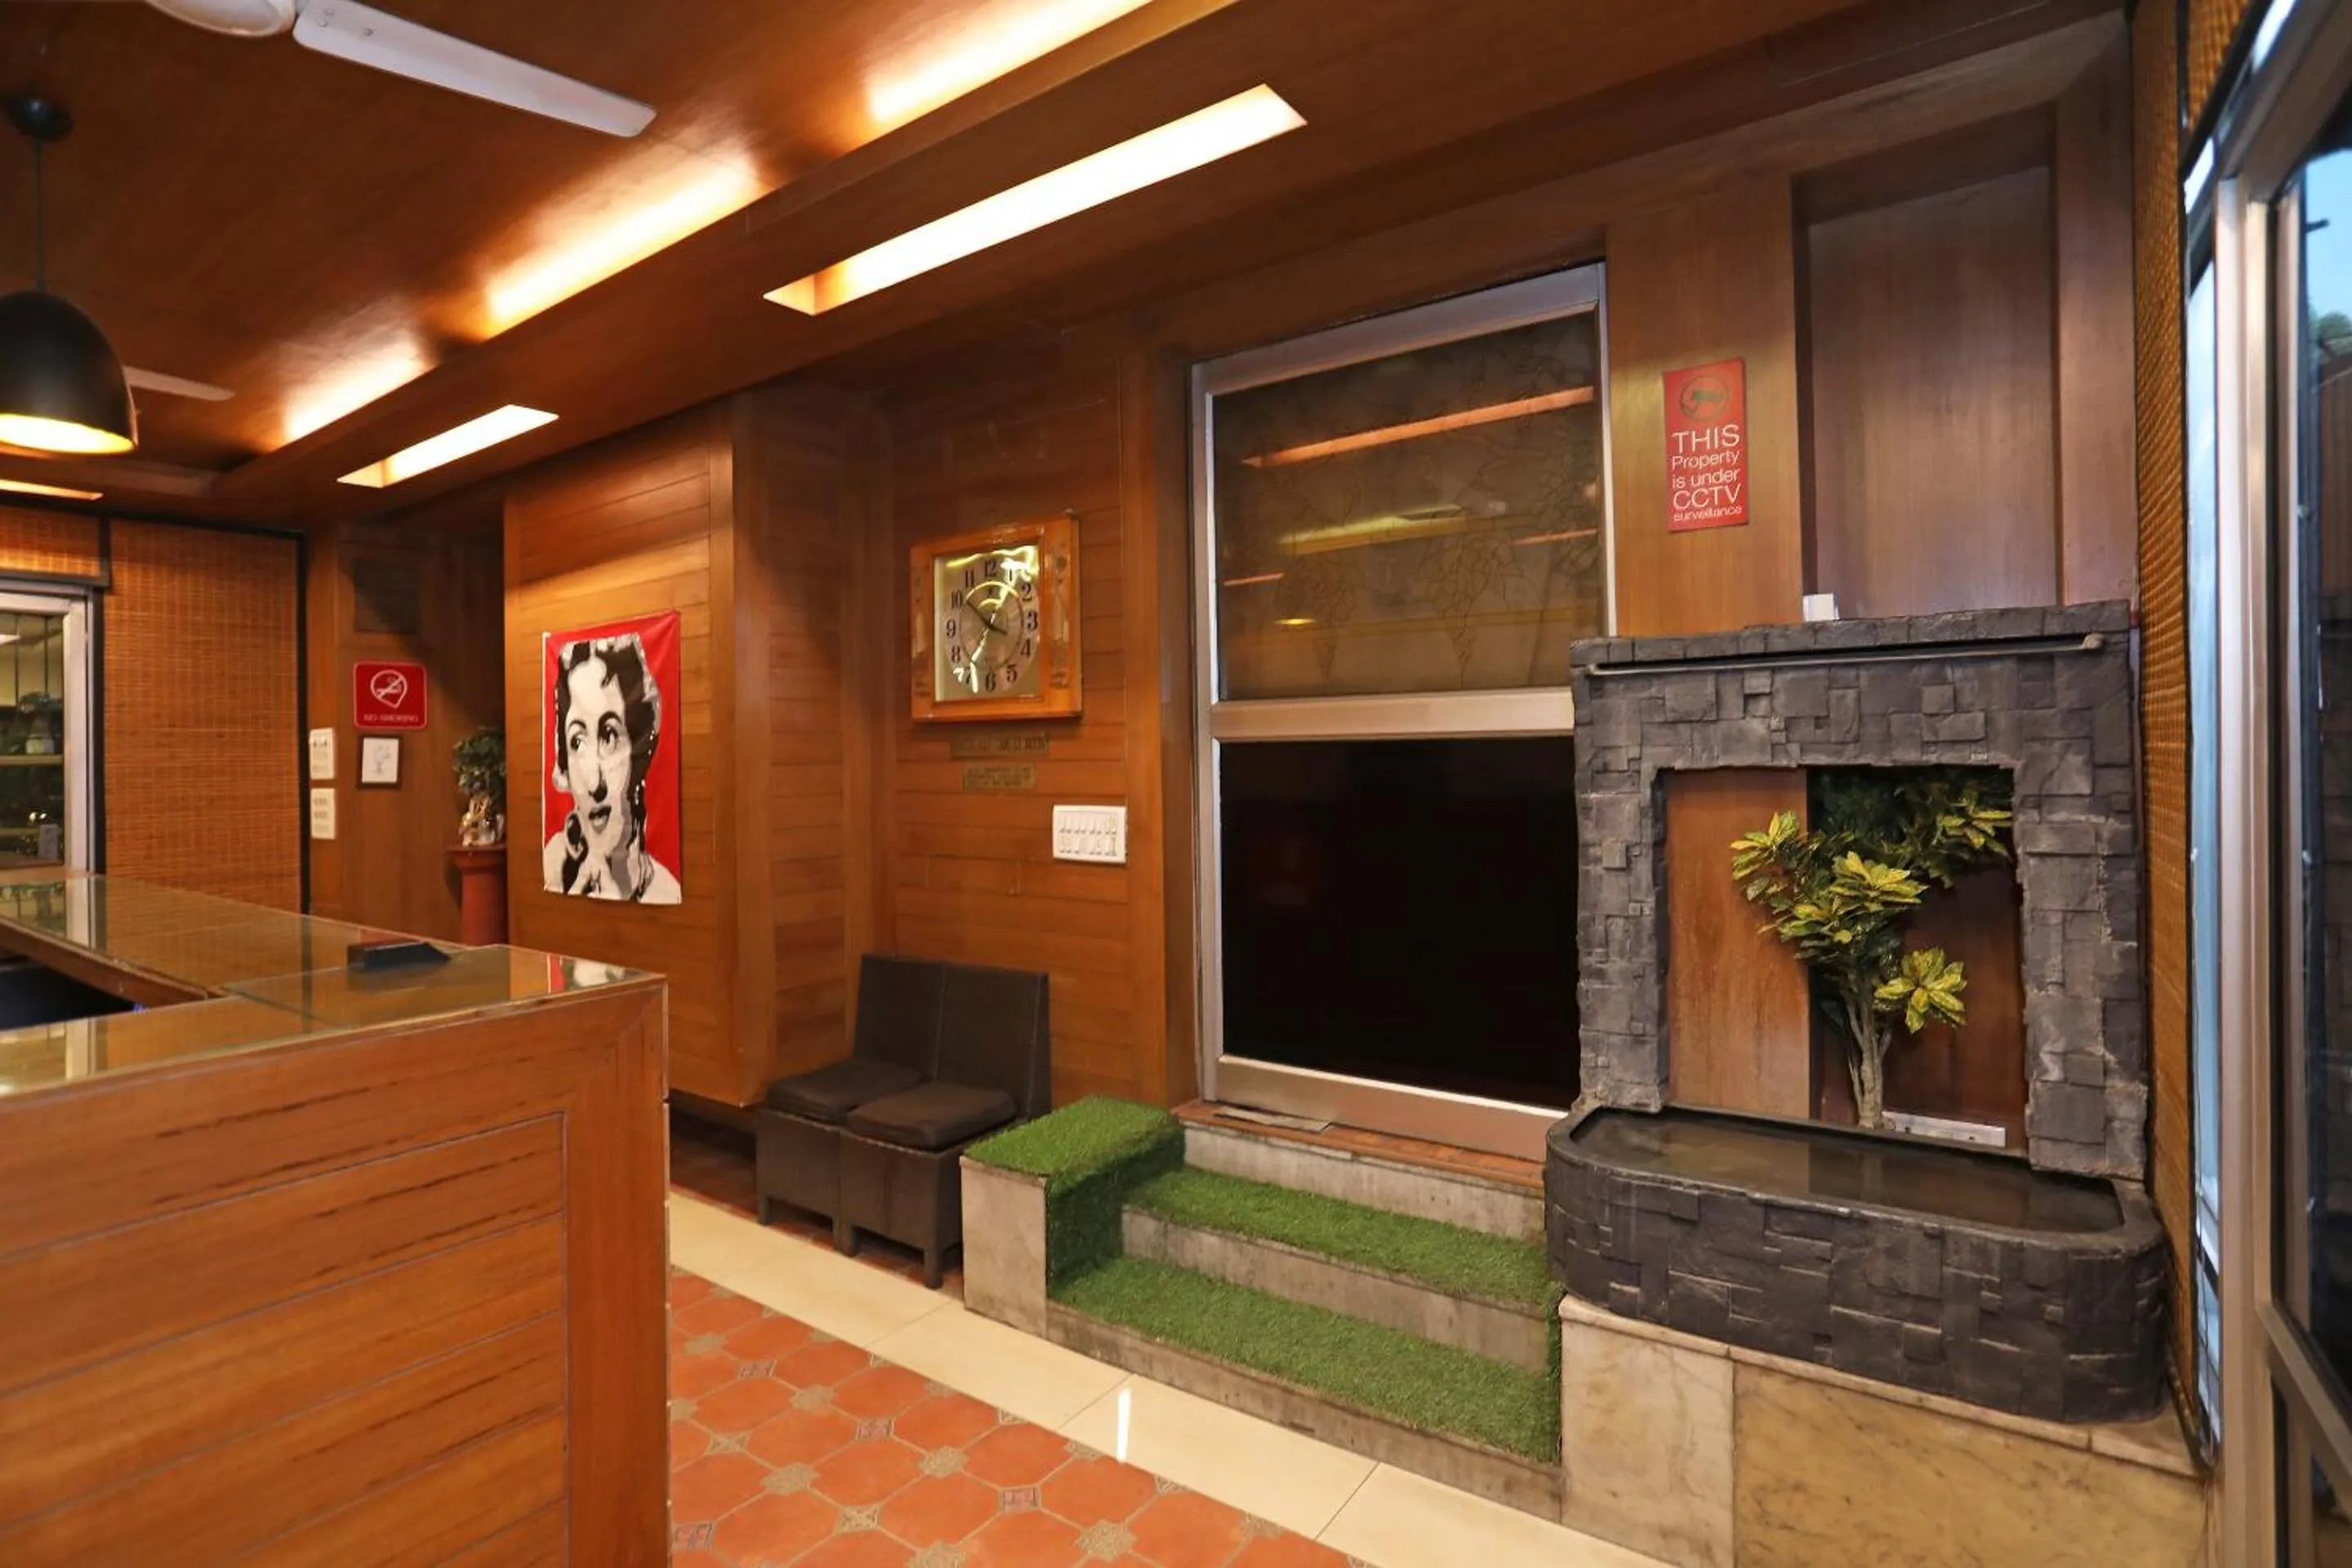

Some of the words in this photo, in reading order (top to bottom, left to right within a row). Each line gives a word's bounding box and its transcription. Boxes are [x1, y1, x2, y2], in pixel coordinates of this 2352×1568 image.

[1671, 424, 1740, 454] THIS
[1672, 448, 1740, 470] Property
[1672, 474, 1686, 489] is
[1690, 468, 1740, 488] under
[1673, 483, 1741, 510] CCTV
[1673, 504, 1744, 522] surveillance
[985, 559, 998, 577] 12
[964, 570, 975, 589] 11
[951, 590, 964, 609] 10
[1022, 583, 1032, 602] 2
[947, 619, 957, 638] 9
[1027, 610, 1039, 631] 3
[951, 646, 961, 663] 8
[1022, 638, 1031, 656] 4
[985, 672, 996, 693] 6
[1006, 663, 1018, 683] 5
